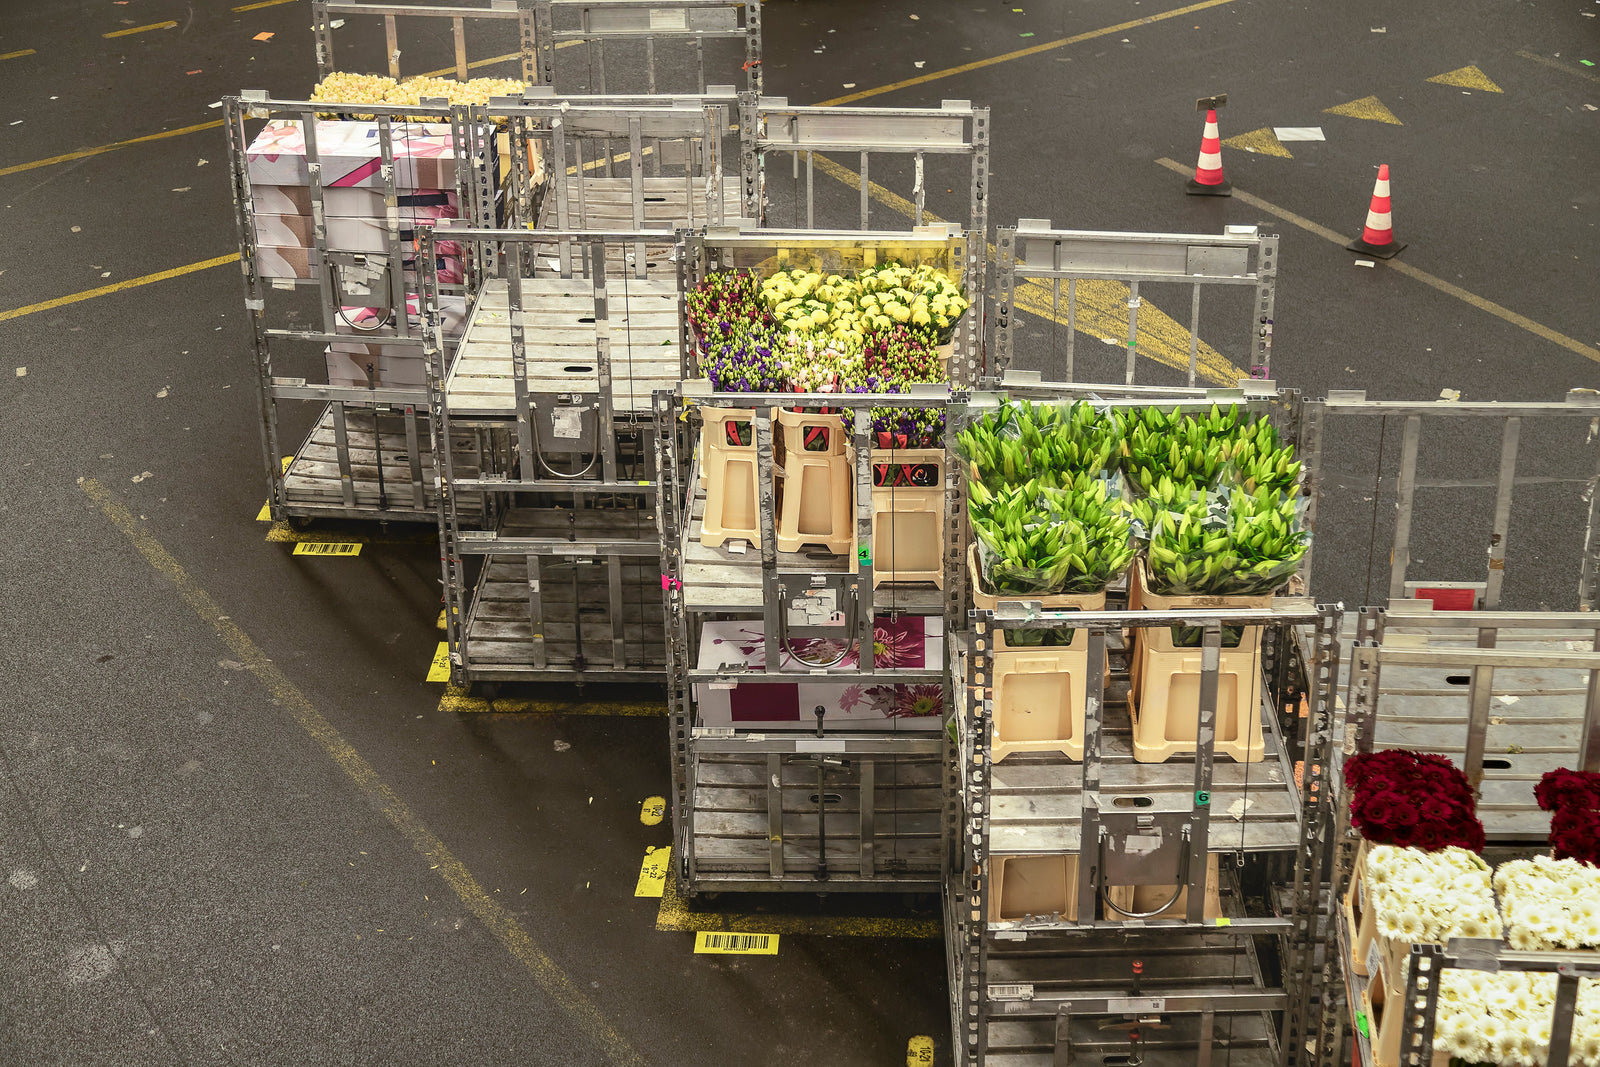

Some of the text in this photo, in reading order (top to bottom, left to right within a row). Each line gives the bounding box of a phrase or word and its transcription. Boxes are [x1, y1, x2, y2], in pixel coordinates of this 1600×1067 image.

[858, 550, 868, 558] 4
[1199, 793, 1208, 801] 6
[649, 864, 659, 879] 10-22
[920, 1047, 931, 1062] 10-21
